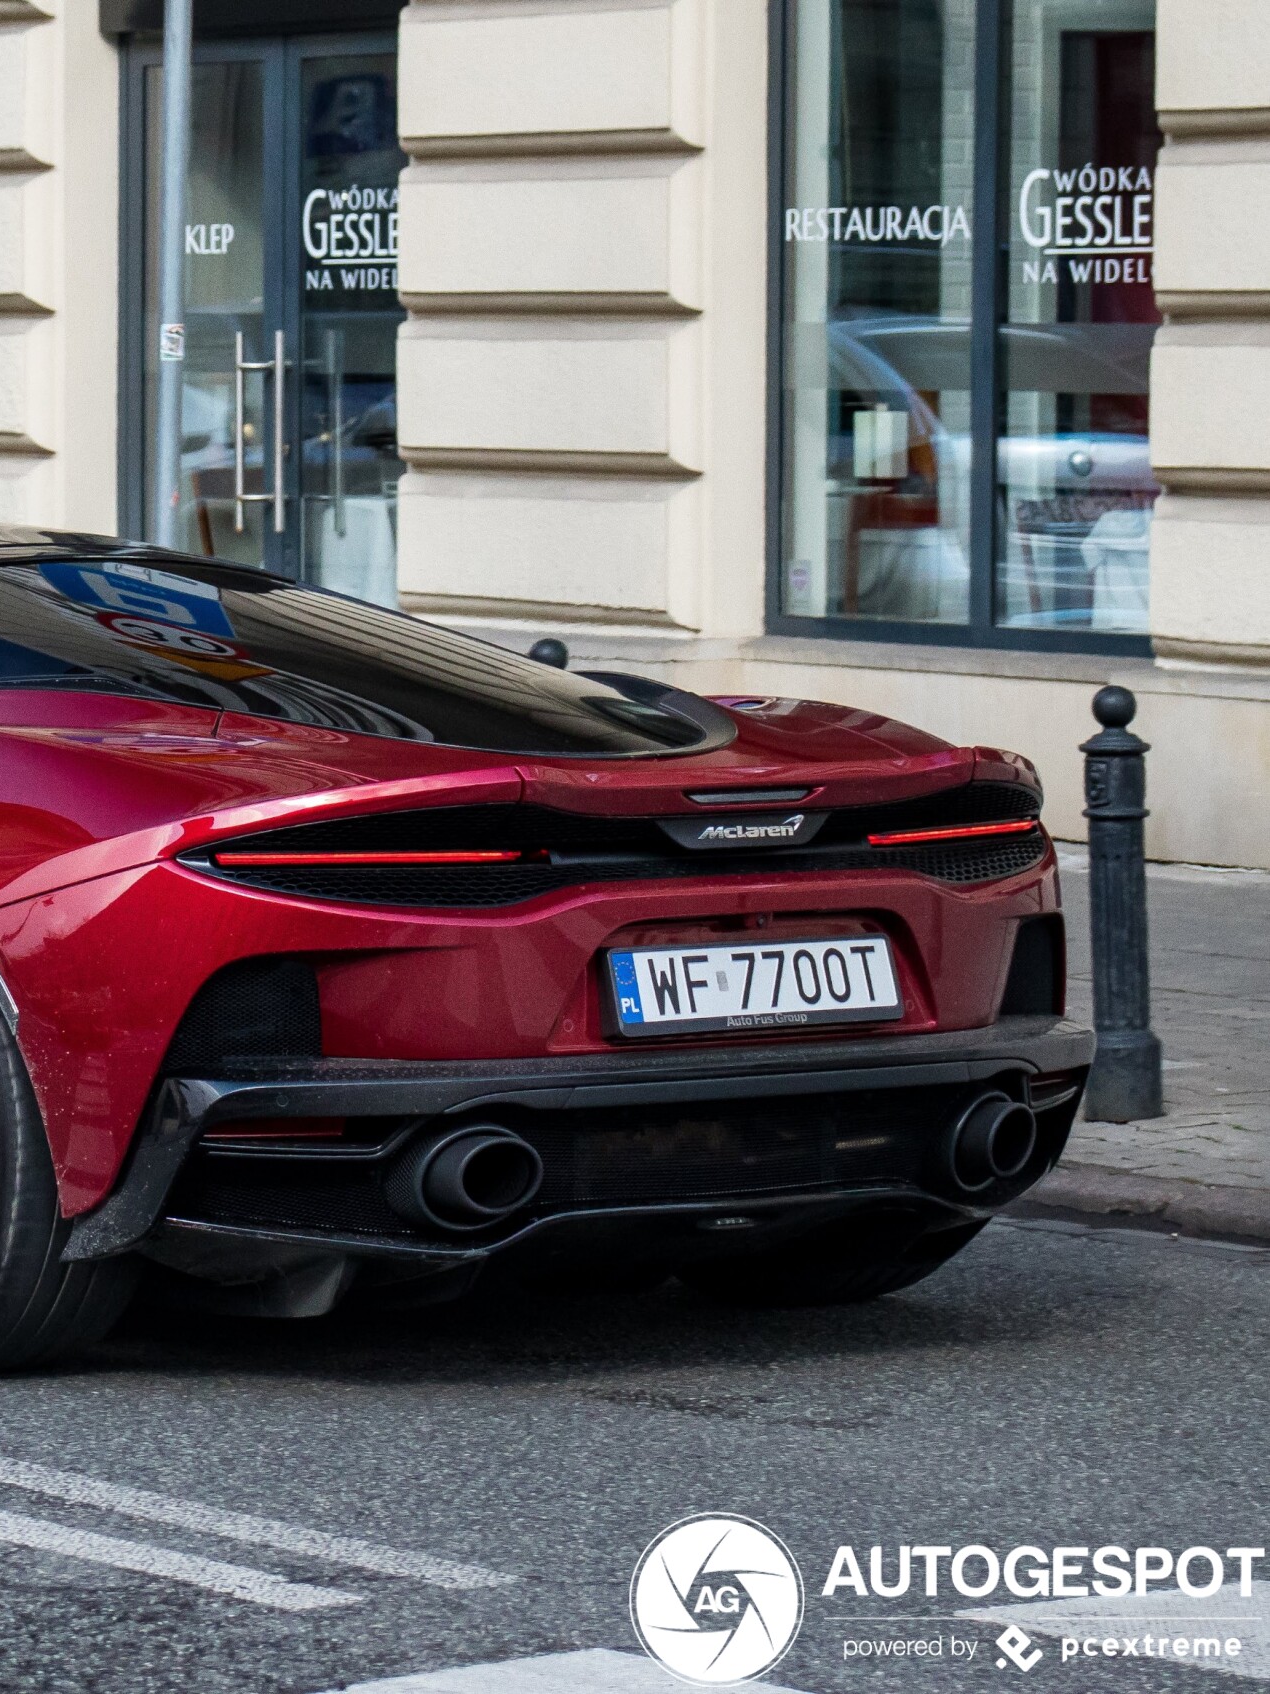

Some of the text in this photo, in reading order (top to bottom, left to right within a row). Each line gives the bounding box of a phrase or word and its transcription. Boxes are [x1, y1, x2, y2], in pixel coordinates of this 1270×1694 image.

[1054, 161, 1152, 193] WÓDKA
[1019, 168, 1152, 247] GESSLE
[302, 188, 399, 259] GESSLE
[784, 205, 972, 248] RESTAURACJA
[306, 269, 334, 291] NA
[1022, 257, 1152, 285] NA WIDEL
[697, 824, 795, 840] McLaren
[647, 945, 877, 1016] WF 7700T
[621, 997, 640, 1014] PL
[726, 1012, 809, 1027] Auto Fus Group
